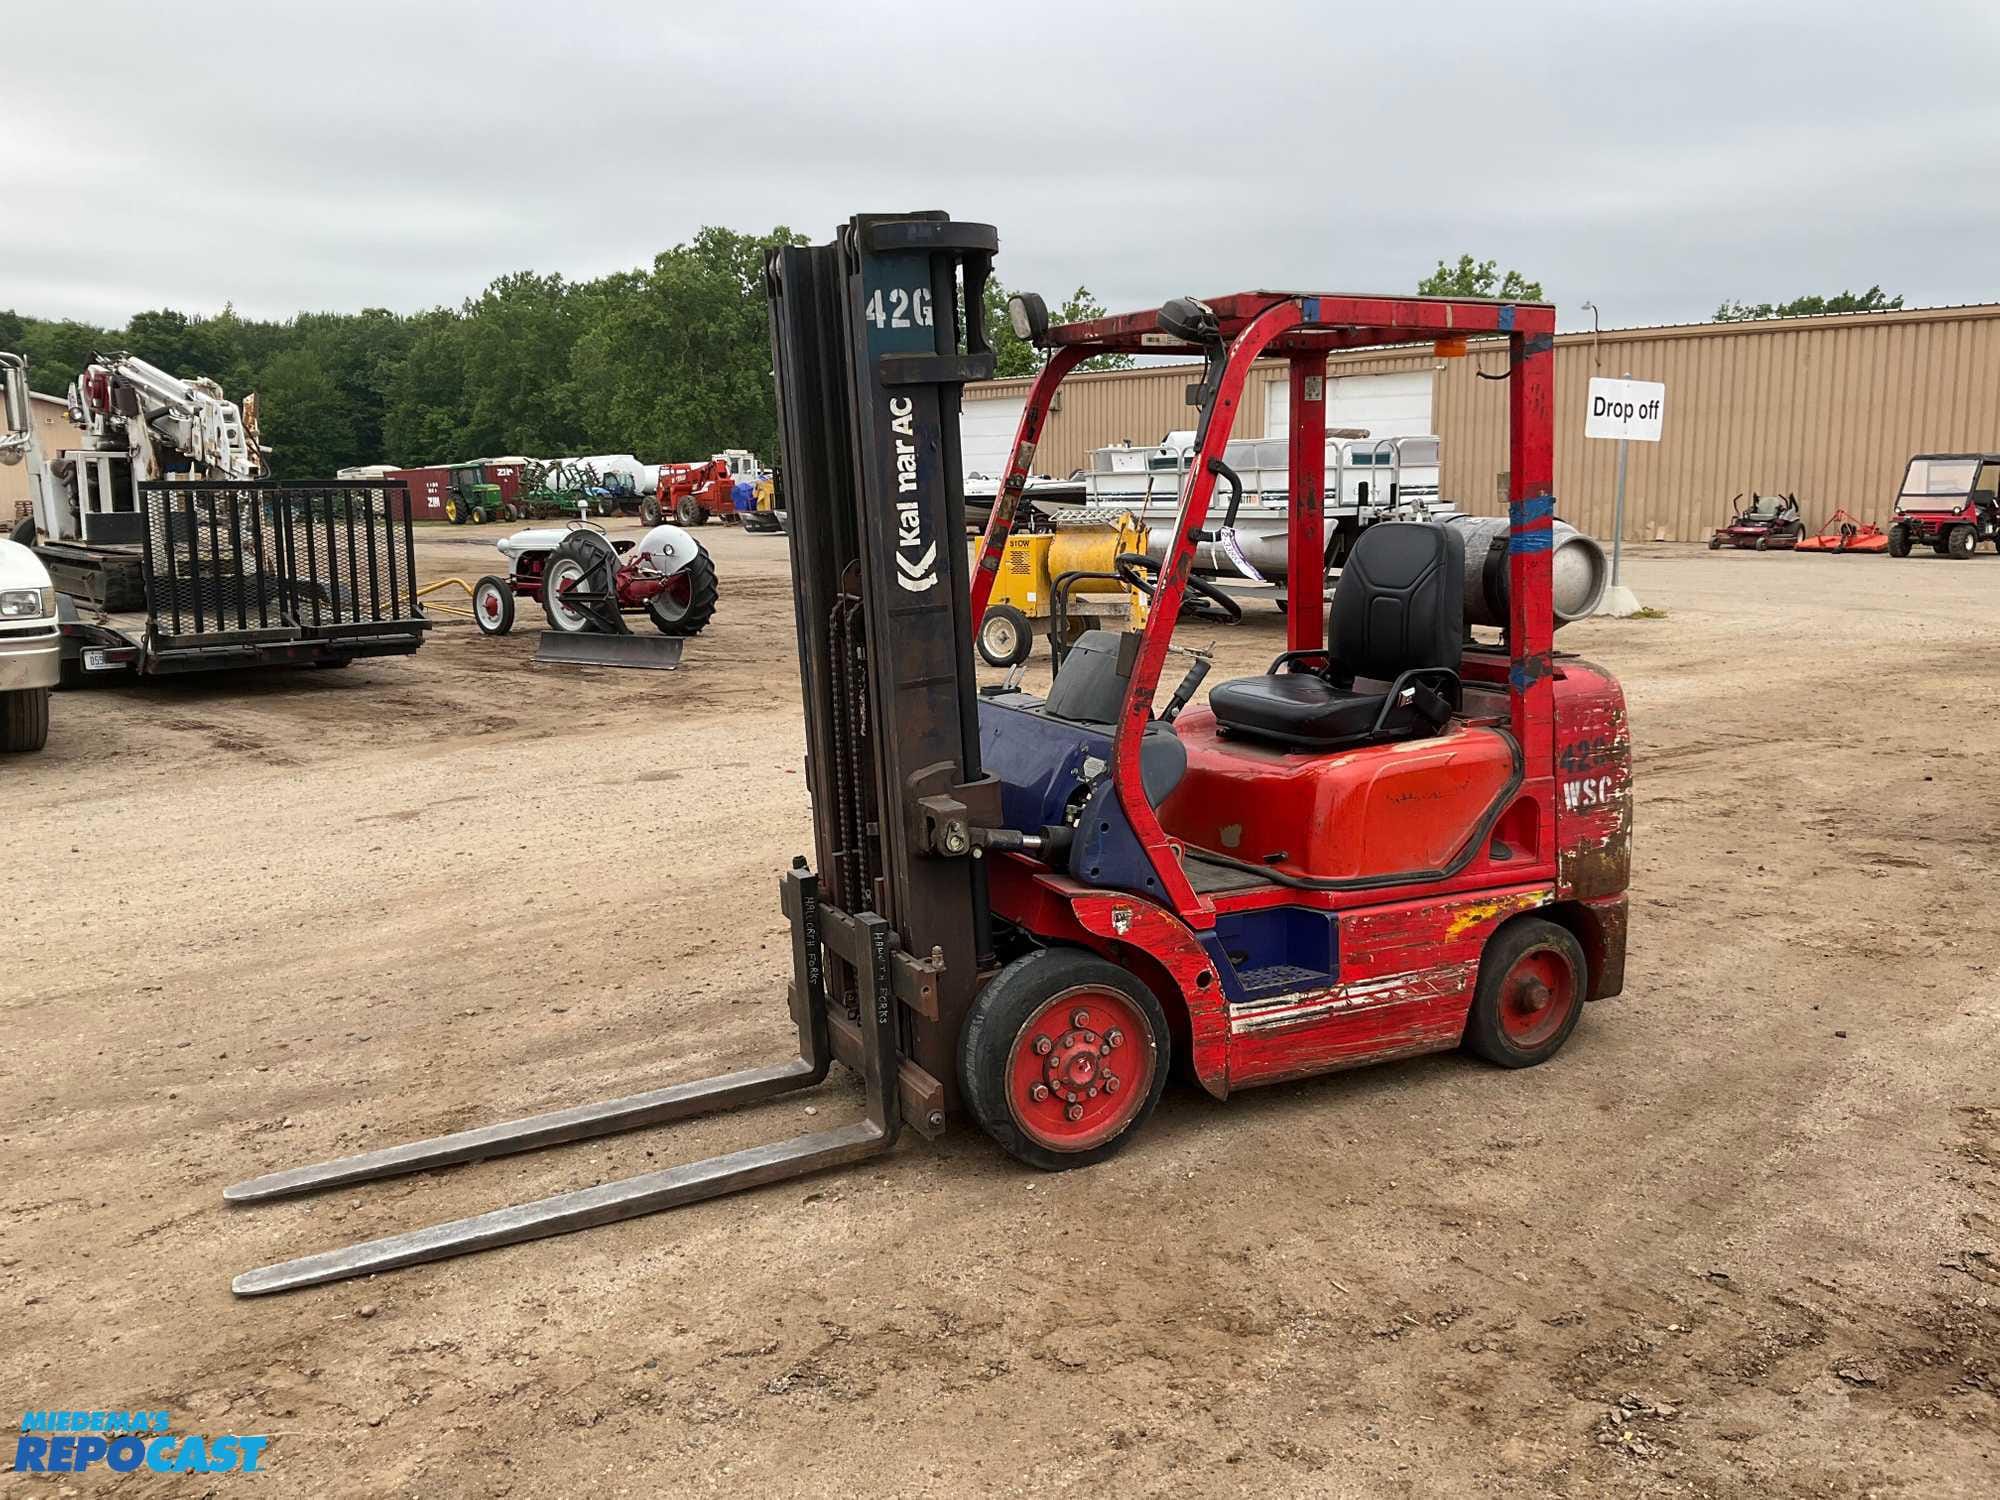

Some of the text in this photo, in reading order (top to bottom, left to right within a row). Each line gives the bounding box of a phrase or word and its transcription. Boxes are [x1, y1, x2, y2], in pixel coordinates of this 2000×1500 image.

[864, 287, 934, 329] 42G
[889, 397, 914, 436] AC
[1593, 396, 1660, 424] Drop off
[1009, 540, 1030, 548] STOW
